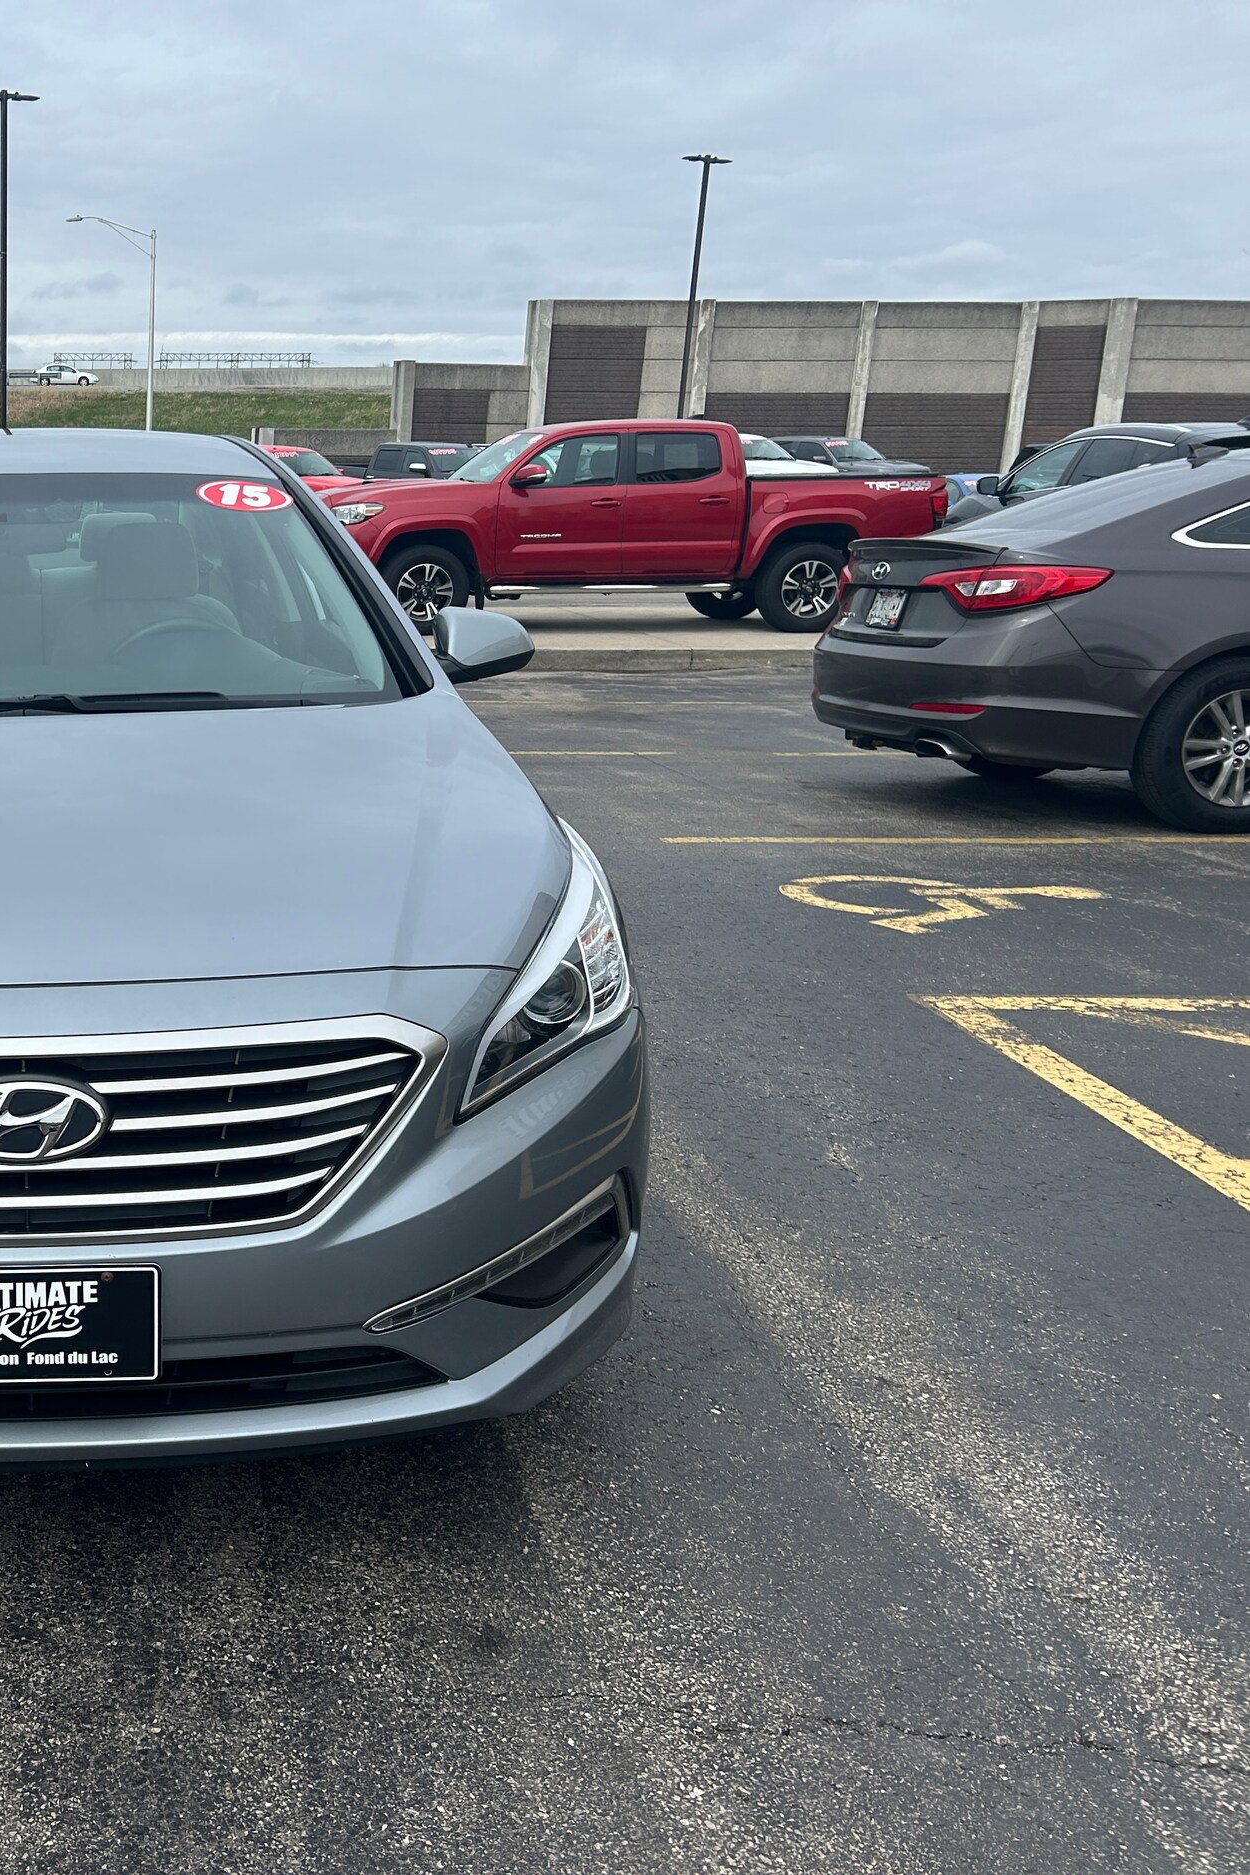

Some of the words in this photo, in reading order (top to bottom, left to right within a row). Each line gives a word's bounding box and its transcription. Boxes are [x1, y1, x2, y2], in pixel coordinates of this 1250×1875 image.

[864, 480, 900, 491] TRD
[219, 483, 272, 508] 15
[26, 1351, 65, 1366] Fond
[67, 1351, 88, 1365] du
[91, 1351, 119, 1364] Lac
